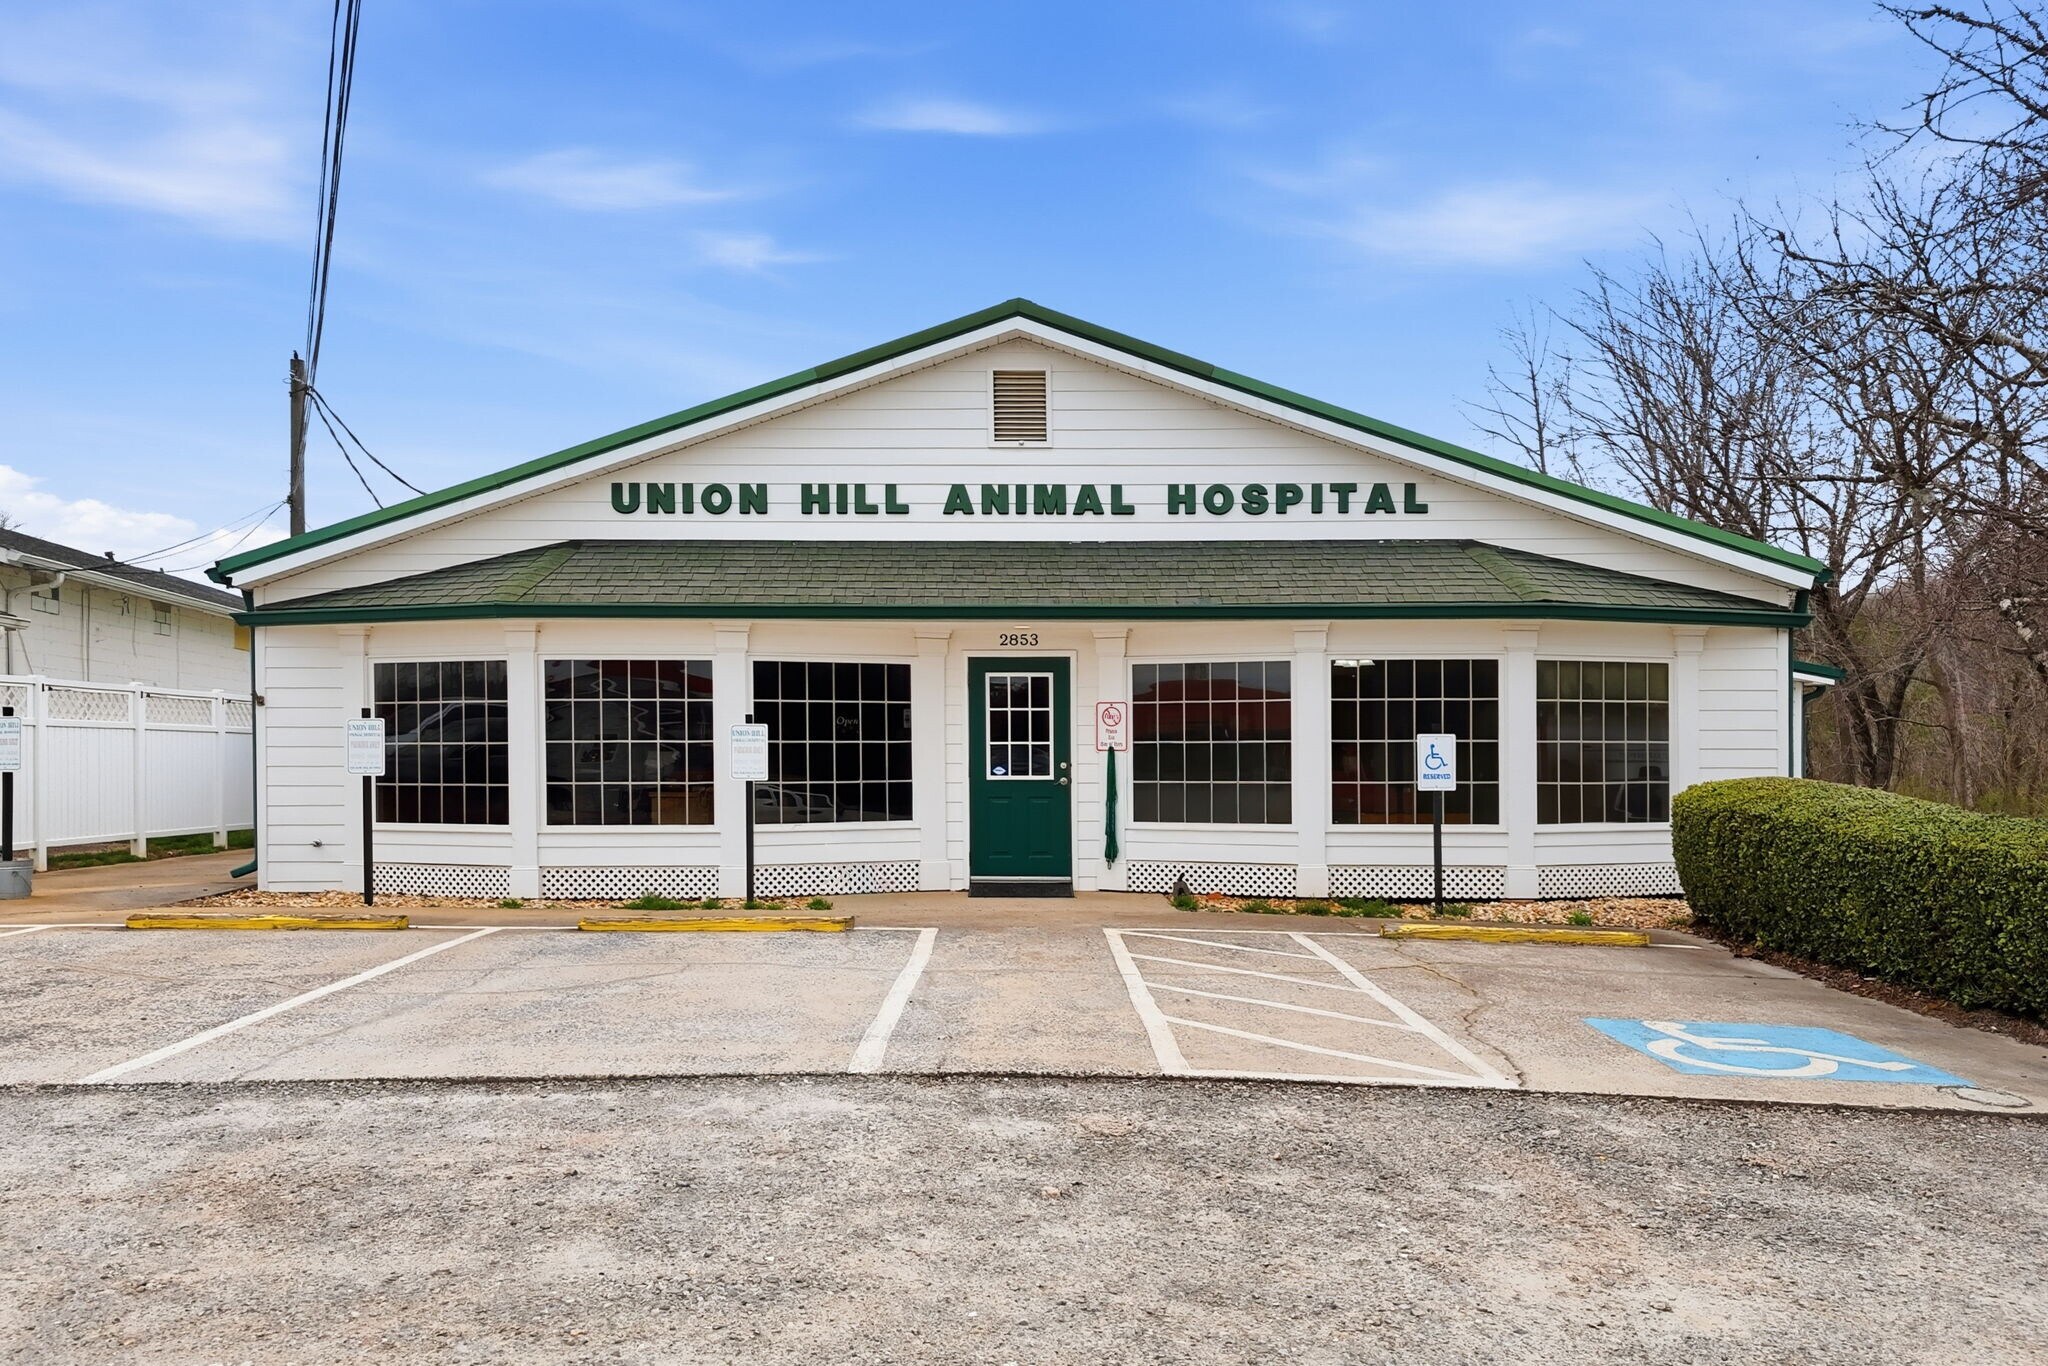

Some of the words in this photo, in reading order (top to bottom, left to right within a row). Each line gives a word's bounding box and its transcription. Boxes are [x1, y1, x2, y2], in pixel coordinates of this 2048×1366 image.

[611, 482, 768, 514] UNION
[800, 483, 910, 514] HILL
[943, 483, 1135, 515] ANIMAL
[1167, 483, 1429, 515] HOSPITAL
[999, 633, 1039, 646] 2853
[836, 716, 859, 727] Open
